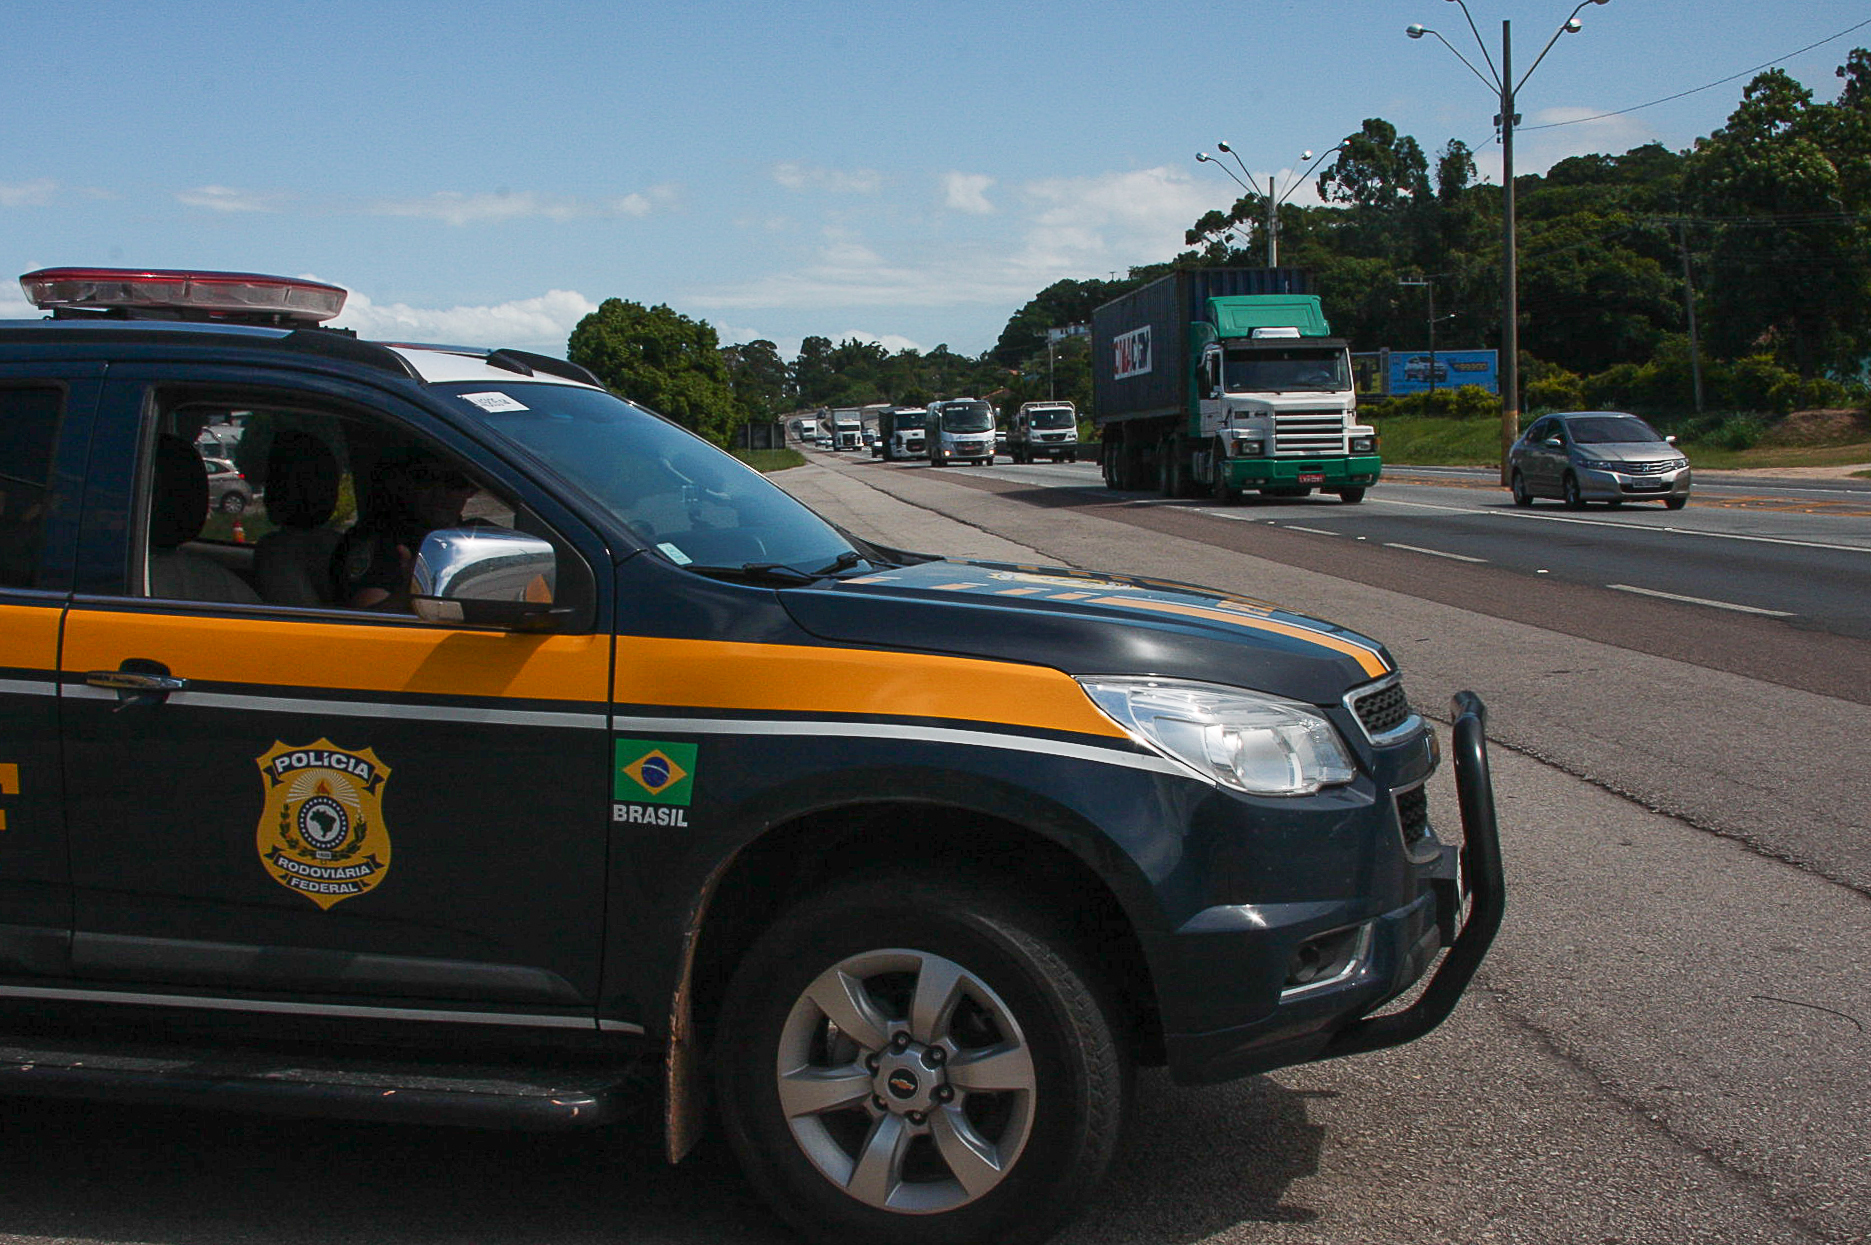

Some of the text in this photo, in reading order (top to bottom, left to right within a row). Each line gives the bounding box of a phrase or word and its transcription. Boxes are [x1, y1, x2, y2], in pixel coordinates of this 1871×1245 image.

[275, 752, 369, 780] POLÍCIA
[612, 804, 688, 828] BRASIL
[277, 857, 371, 879] RODOVIÁRIA
[290, 877, 359, 893] FEDERAL
